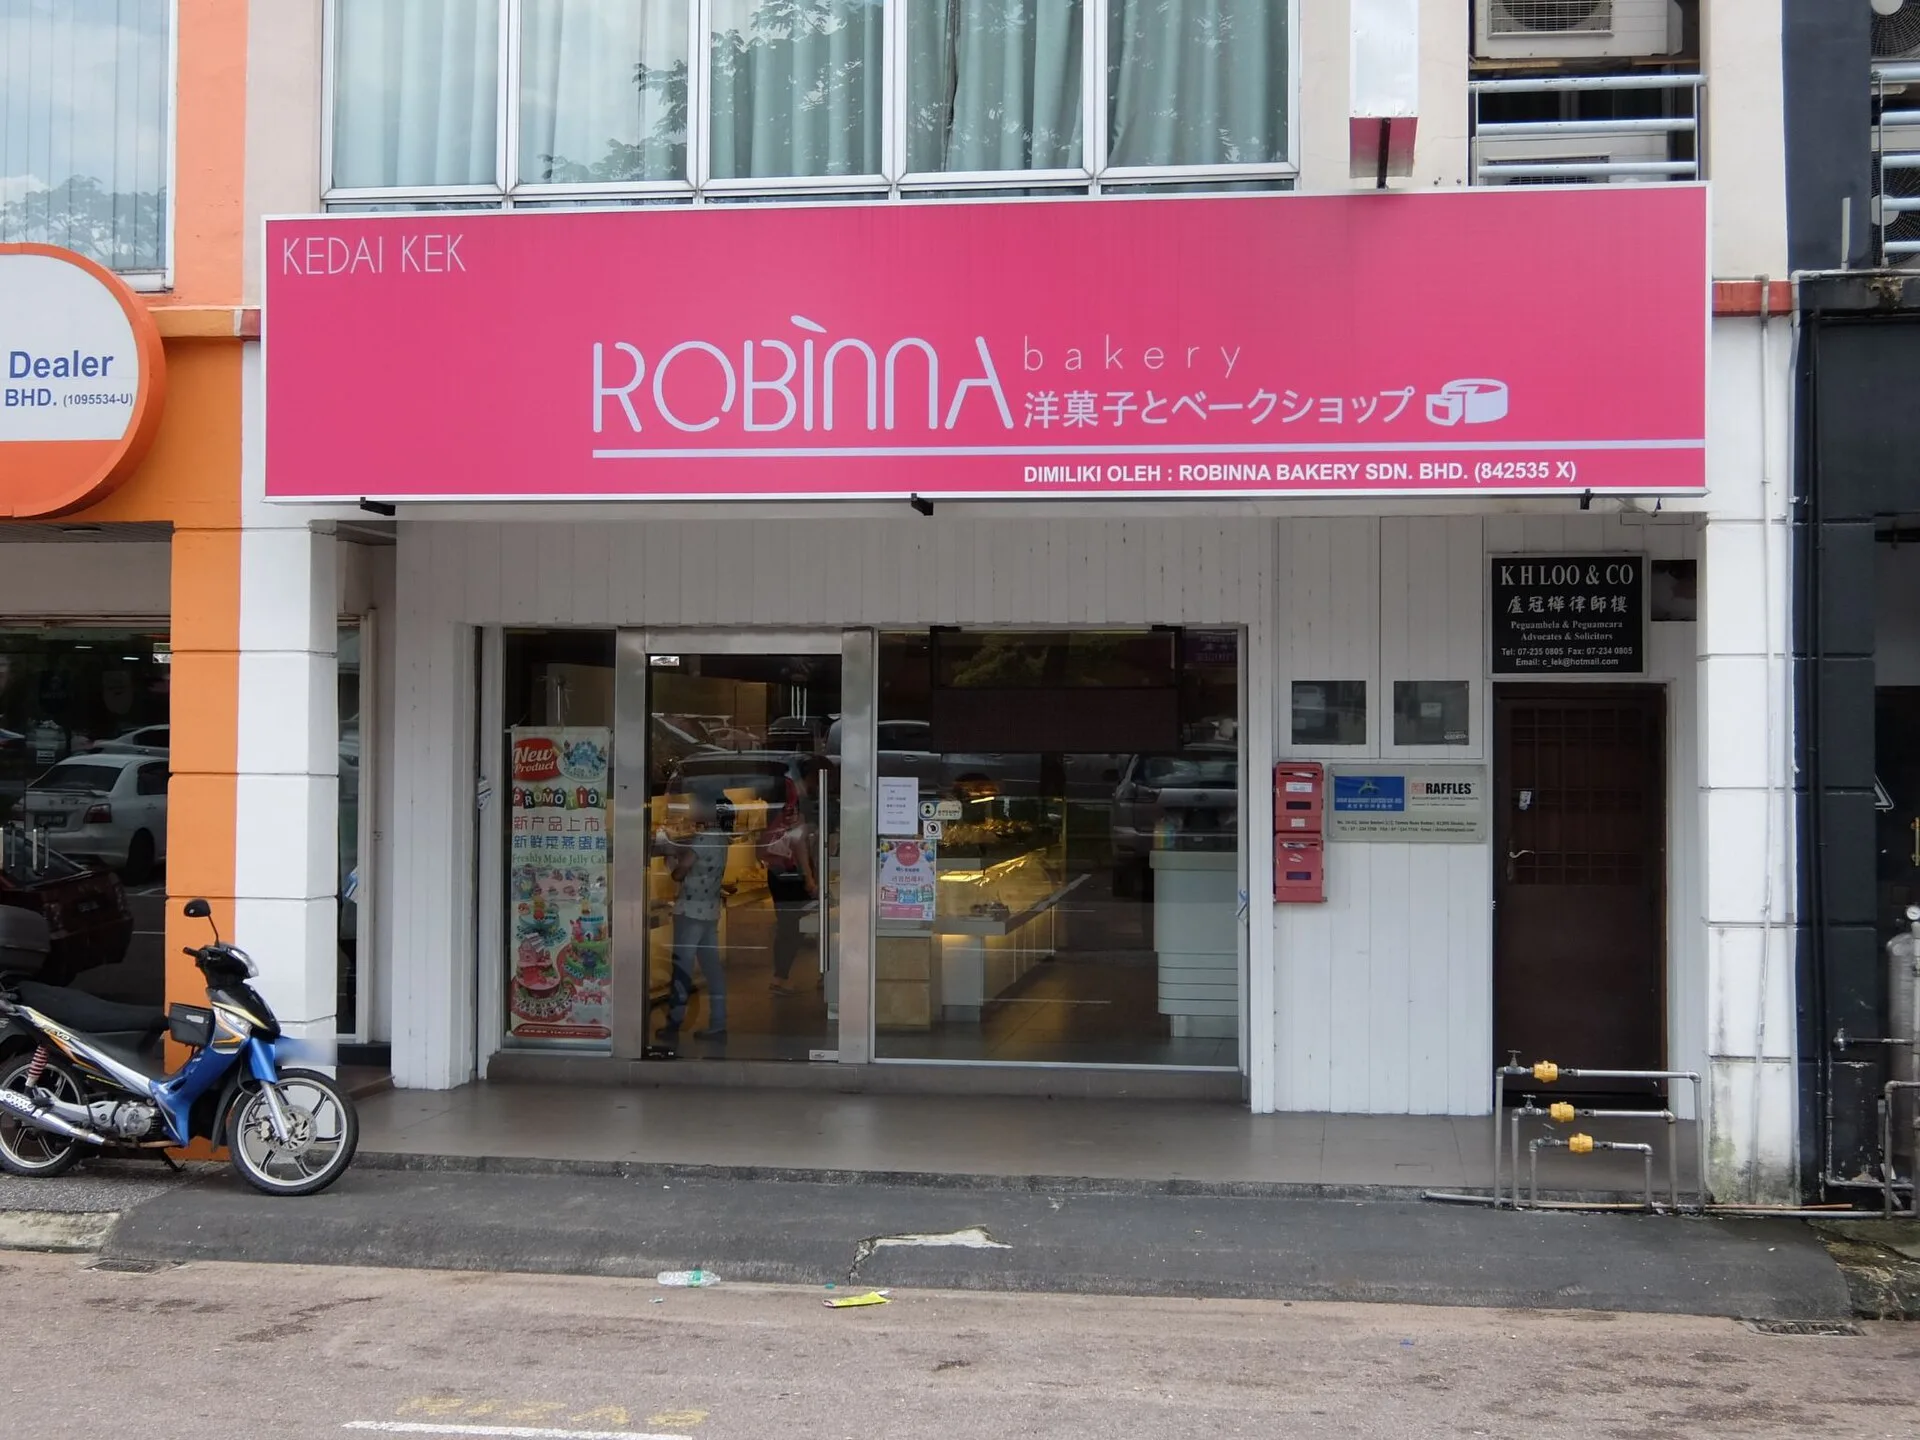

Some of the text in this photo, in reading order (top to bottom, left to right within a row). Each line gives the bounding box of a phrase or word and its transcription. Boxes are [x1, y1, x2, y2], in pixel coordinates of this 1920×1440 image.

[283, 234, 467, 275] KEDAI KEK
[9, 349, 114, 379] Dealer
[1023, 333, 1242, 379] bakery
[5, 388, 134, 408] BHD. (1095534-U)
[1023, 385, 1416, 429] 洋菓子とベークショップ
[1023, 465, 1102, 484] DIMILIKI
[1107, 465, 1161, 483] OLEH
[1179, 464, 1271, 482] ROBINNA
[1276, 463, 1360, 482] BAKERY
[1365, 463, 1414, 481] SDN.
[1419, 462, 1469, 480] BHD.
[1474, 461, 1550, 482] (842535
[1555, 461, 1577, 481] X)
[1500, 564, 1634, 586] K H LOO & CO
[1562, 621, 1570, 629] &
[1520, 631, 1613, 641] Advocates & Solicitors
[1501, 647, 1515, 656] Tel:
[1568, 646, 1585, 655] Fax:
[1516, 657, 1541, 666] Email:
[514, 747, 553, 763] New
[514, 761, 554, 774] Product
[1425, 782, 1472, 795] RAFFLES
[513, 791, 607, 810] PROMOTION
[514, 816, 600, 832] 新产品上市
[544, 853, 567, 864] Made
[569, 853, 588, 866] Jelly
